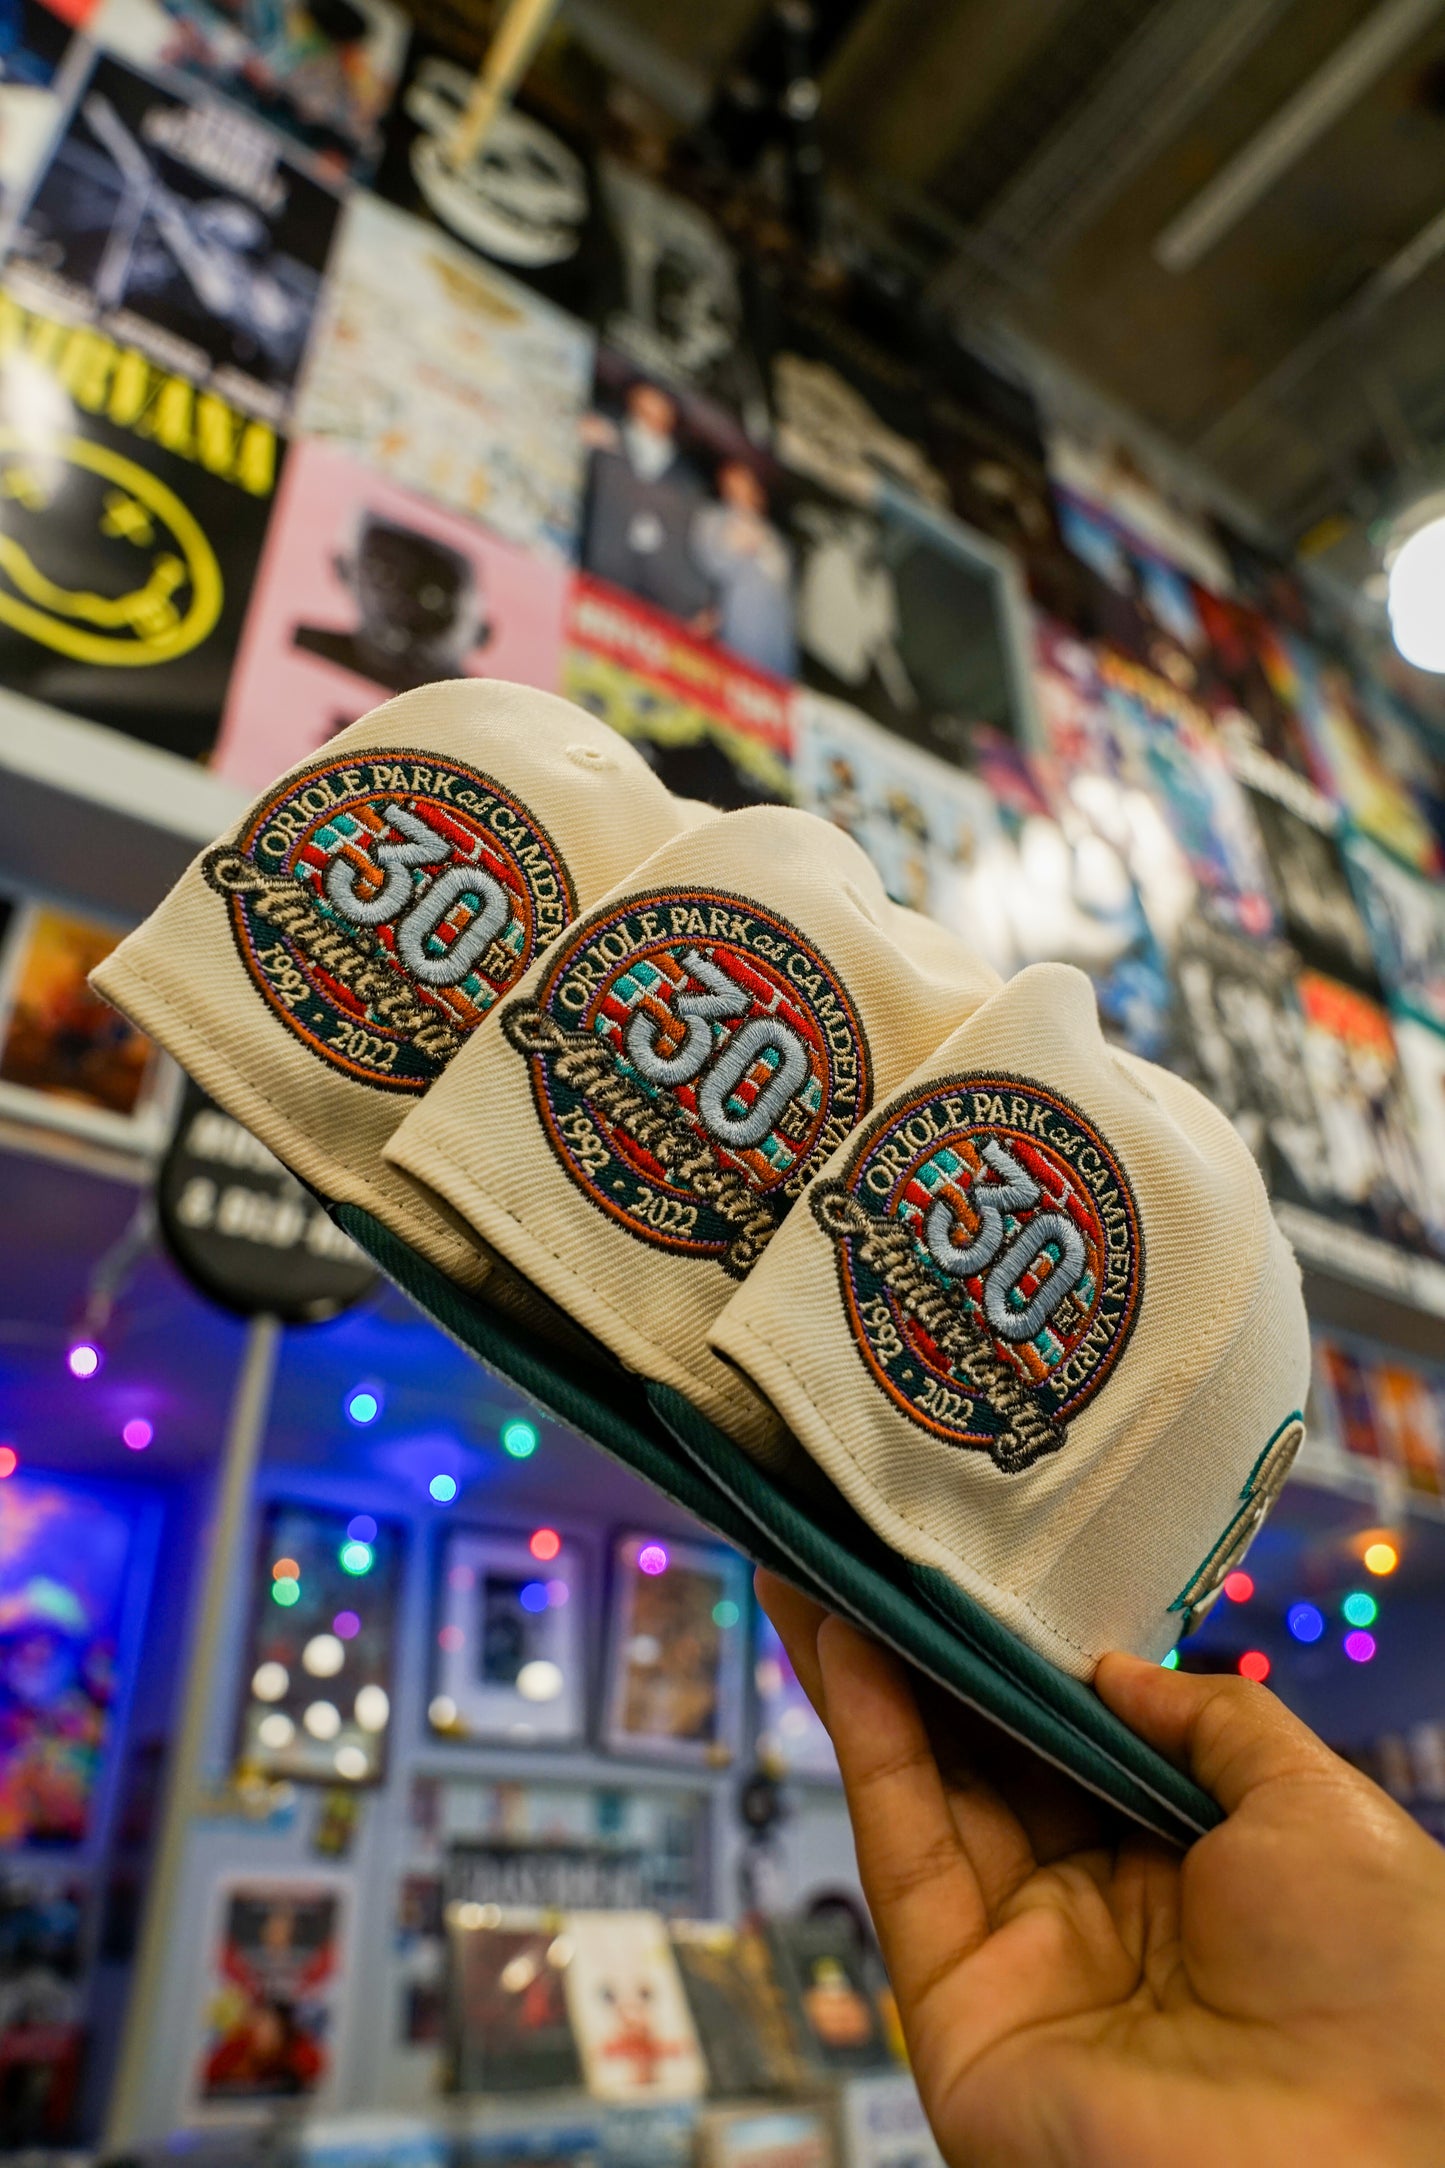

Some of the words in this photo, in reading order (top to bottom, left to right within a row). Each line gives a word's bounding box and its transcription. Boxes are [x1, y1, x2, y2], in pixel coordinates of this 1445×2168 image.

[261, 766, 370, 857] ORIOLE
[370, 764, 459, 802] PARK
[456, 789, 498, 815] at
[489, 806, 563, 945] CAMDEN
[326, 802, 511, 986] 30
[257, 942, 311, 1008] 1992
[326, 1021, 400, 1072] 2022
[559, 914, 668, 1010] ORIOLE
[668, 907, 756, 945] PARK
[752, 934, 791, 961] at
[786, 952, 857, 1104] CAMDEN
[625, 947, 809, 1147] 30
[557, 1105, 611, 1177] 1992
[628, 1186, 698, 1237] 2022
[866, 1097, 970, 1196] ORIOLE
[972, 1092, 1053, 1133] PARK
[1050, 1127, 1086, 1155] at
[926, 1136, 1086, 1340] 30
[1076, 1147, 1131, 1300] CAMDEN
[858, 1294, 904, 1367] 1992
[913, 1377, 974, 1428] 2022
[1050, 1309, 1120, 1400] YARDS
